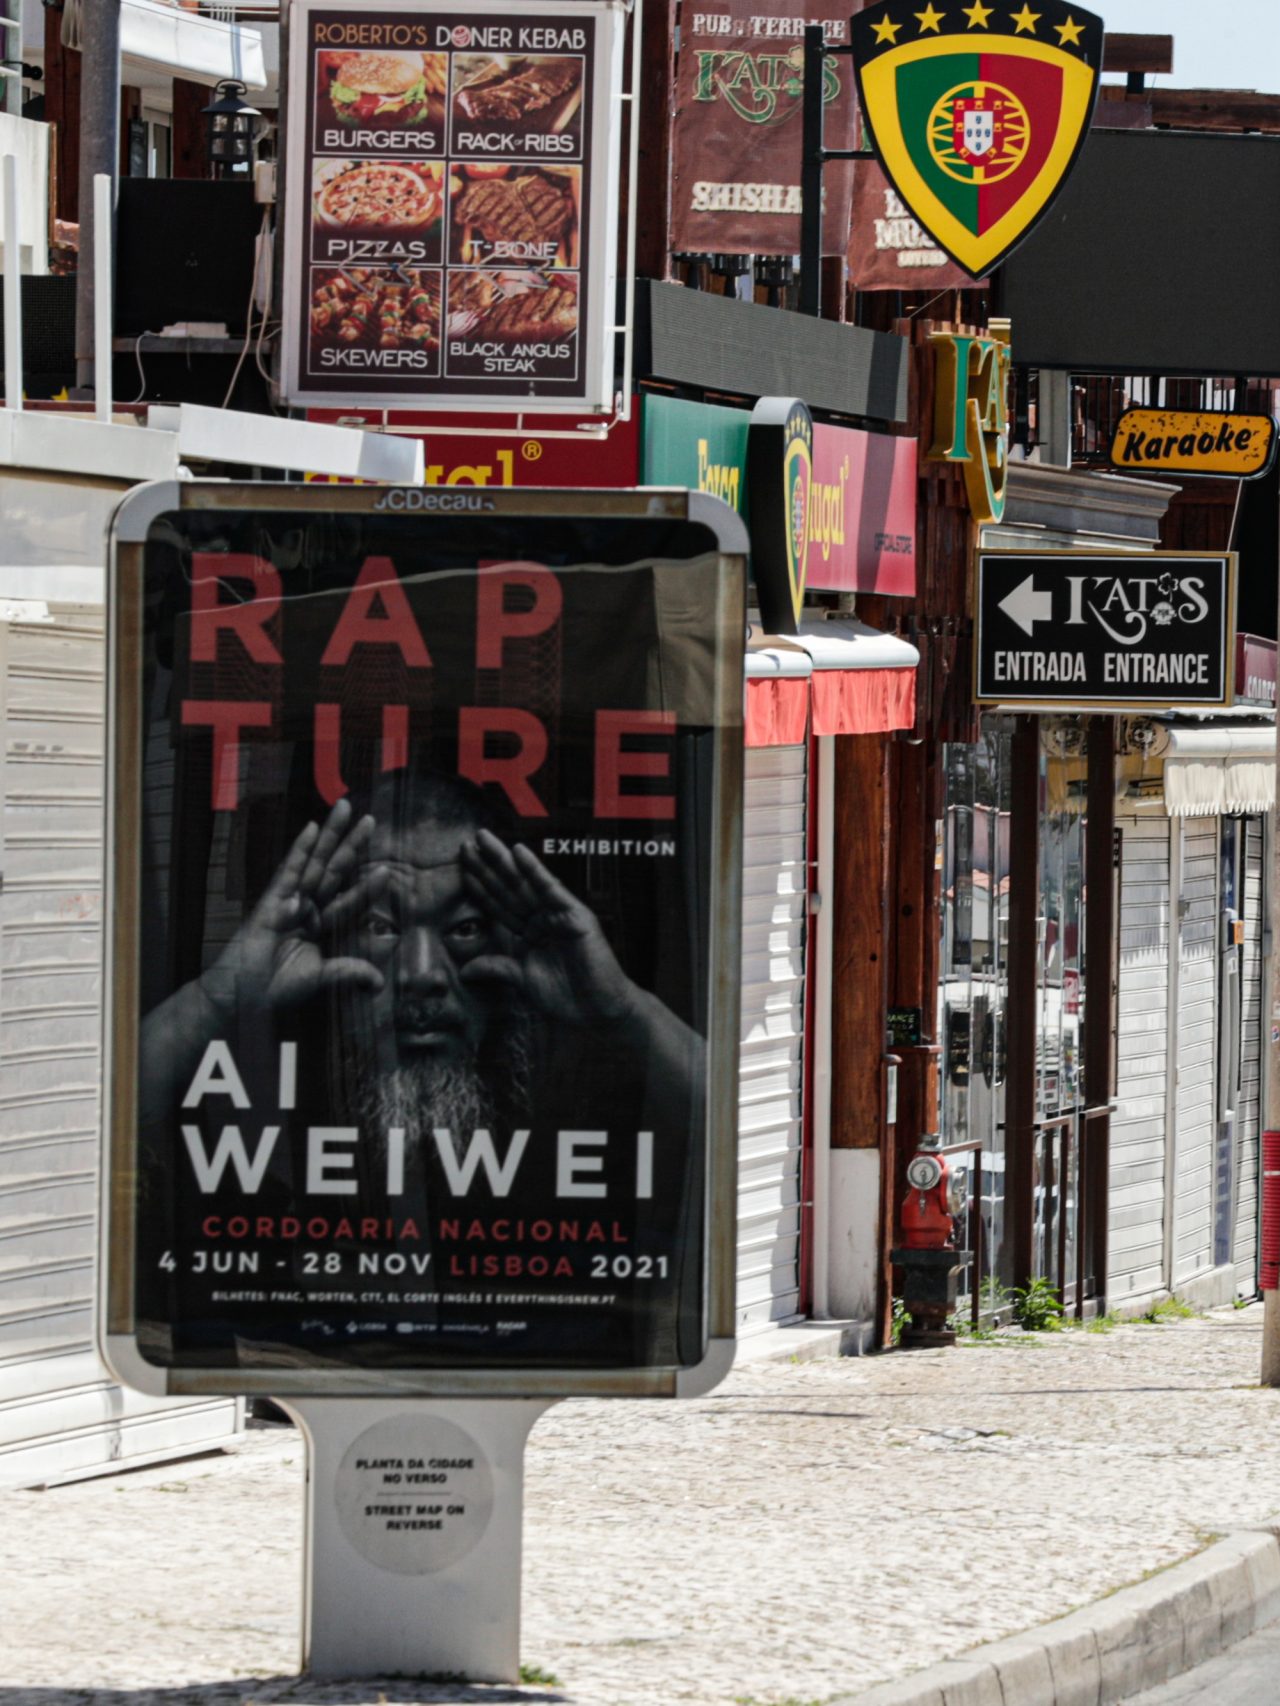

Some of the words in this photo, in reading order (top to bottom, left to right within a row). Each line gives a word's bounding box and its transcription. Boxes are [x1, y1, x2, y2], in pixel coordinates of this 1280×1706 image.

[314, 23, 428, 46] ROBERTO'S
[436, 25, 512, 48] DONER
[518, 28, 586, 49] KEBAB
[692, 14, 731, 34] PUB
[750, 16, 846, 39] TERRCE
[324, 130, 436, 149] BURGERS
[457, 133, 514, 151] RACK
[525, 134, 574, 153] RIBS
[691, 181, 827, 215] SHISHA
[328, 239, 427, 259] PIZZAS
[468, 240, 559, 260] T-BONE
[320, 349, 428, 369] SKEWERS
[450, 342, 506, 357] BLACK
[510, 344, 570, 359] ANGUS
[484, 358, 536, 373] STEAK
[1122, 422, 1253, 462] Karaoke
[189, 552, 563, 669] RAP
[994, 651, 1087, 682] ENTRADA
[1103, 653, 1209, 684] ENTRANCE
[181, 701, 677, 819] TURE
[543, 839, 676, 857] EXHIBITION
[182, 1039, 298, 1110] AI
[181, 1125, 655, 1200] WEIWEI
[202, 1216, 420, 1240] CORDOARIA
[440, 1219, 628, 1243] NACIONAL
[158, 1250, 177, 1273] 4
[192, 1251, 259, 1274] JUN
[303, 1252, 342, 1274] 28
[358, 1253, 432, 1276] NOV
[450, 1255, 574, 1277] LISBOA
[590, 1256, 669, 1278] 2021
[387, 1293, 400, 1303] EL
[404, 1293, 440, 1303] CORTE
[356, 1459, 403, 1470] PLANTA
[408, 1459, 424, 1469] DA
[429, 1459, 474, 1470] CIDADE
[383, 1474, 401, 1484] NO
[405, 1473, 447, 1485] VERSO
[365, 1505, 412, 1516] STREET
[416, 1505, 443, 1516] MAP
[446, 1505, 465, 1516] ON
[386, 1520, 442, 1531] REVERSE
